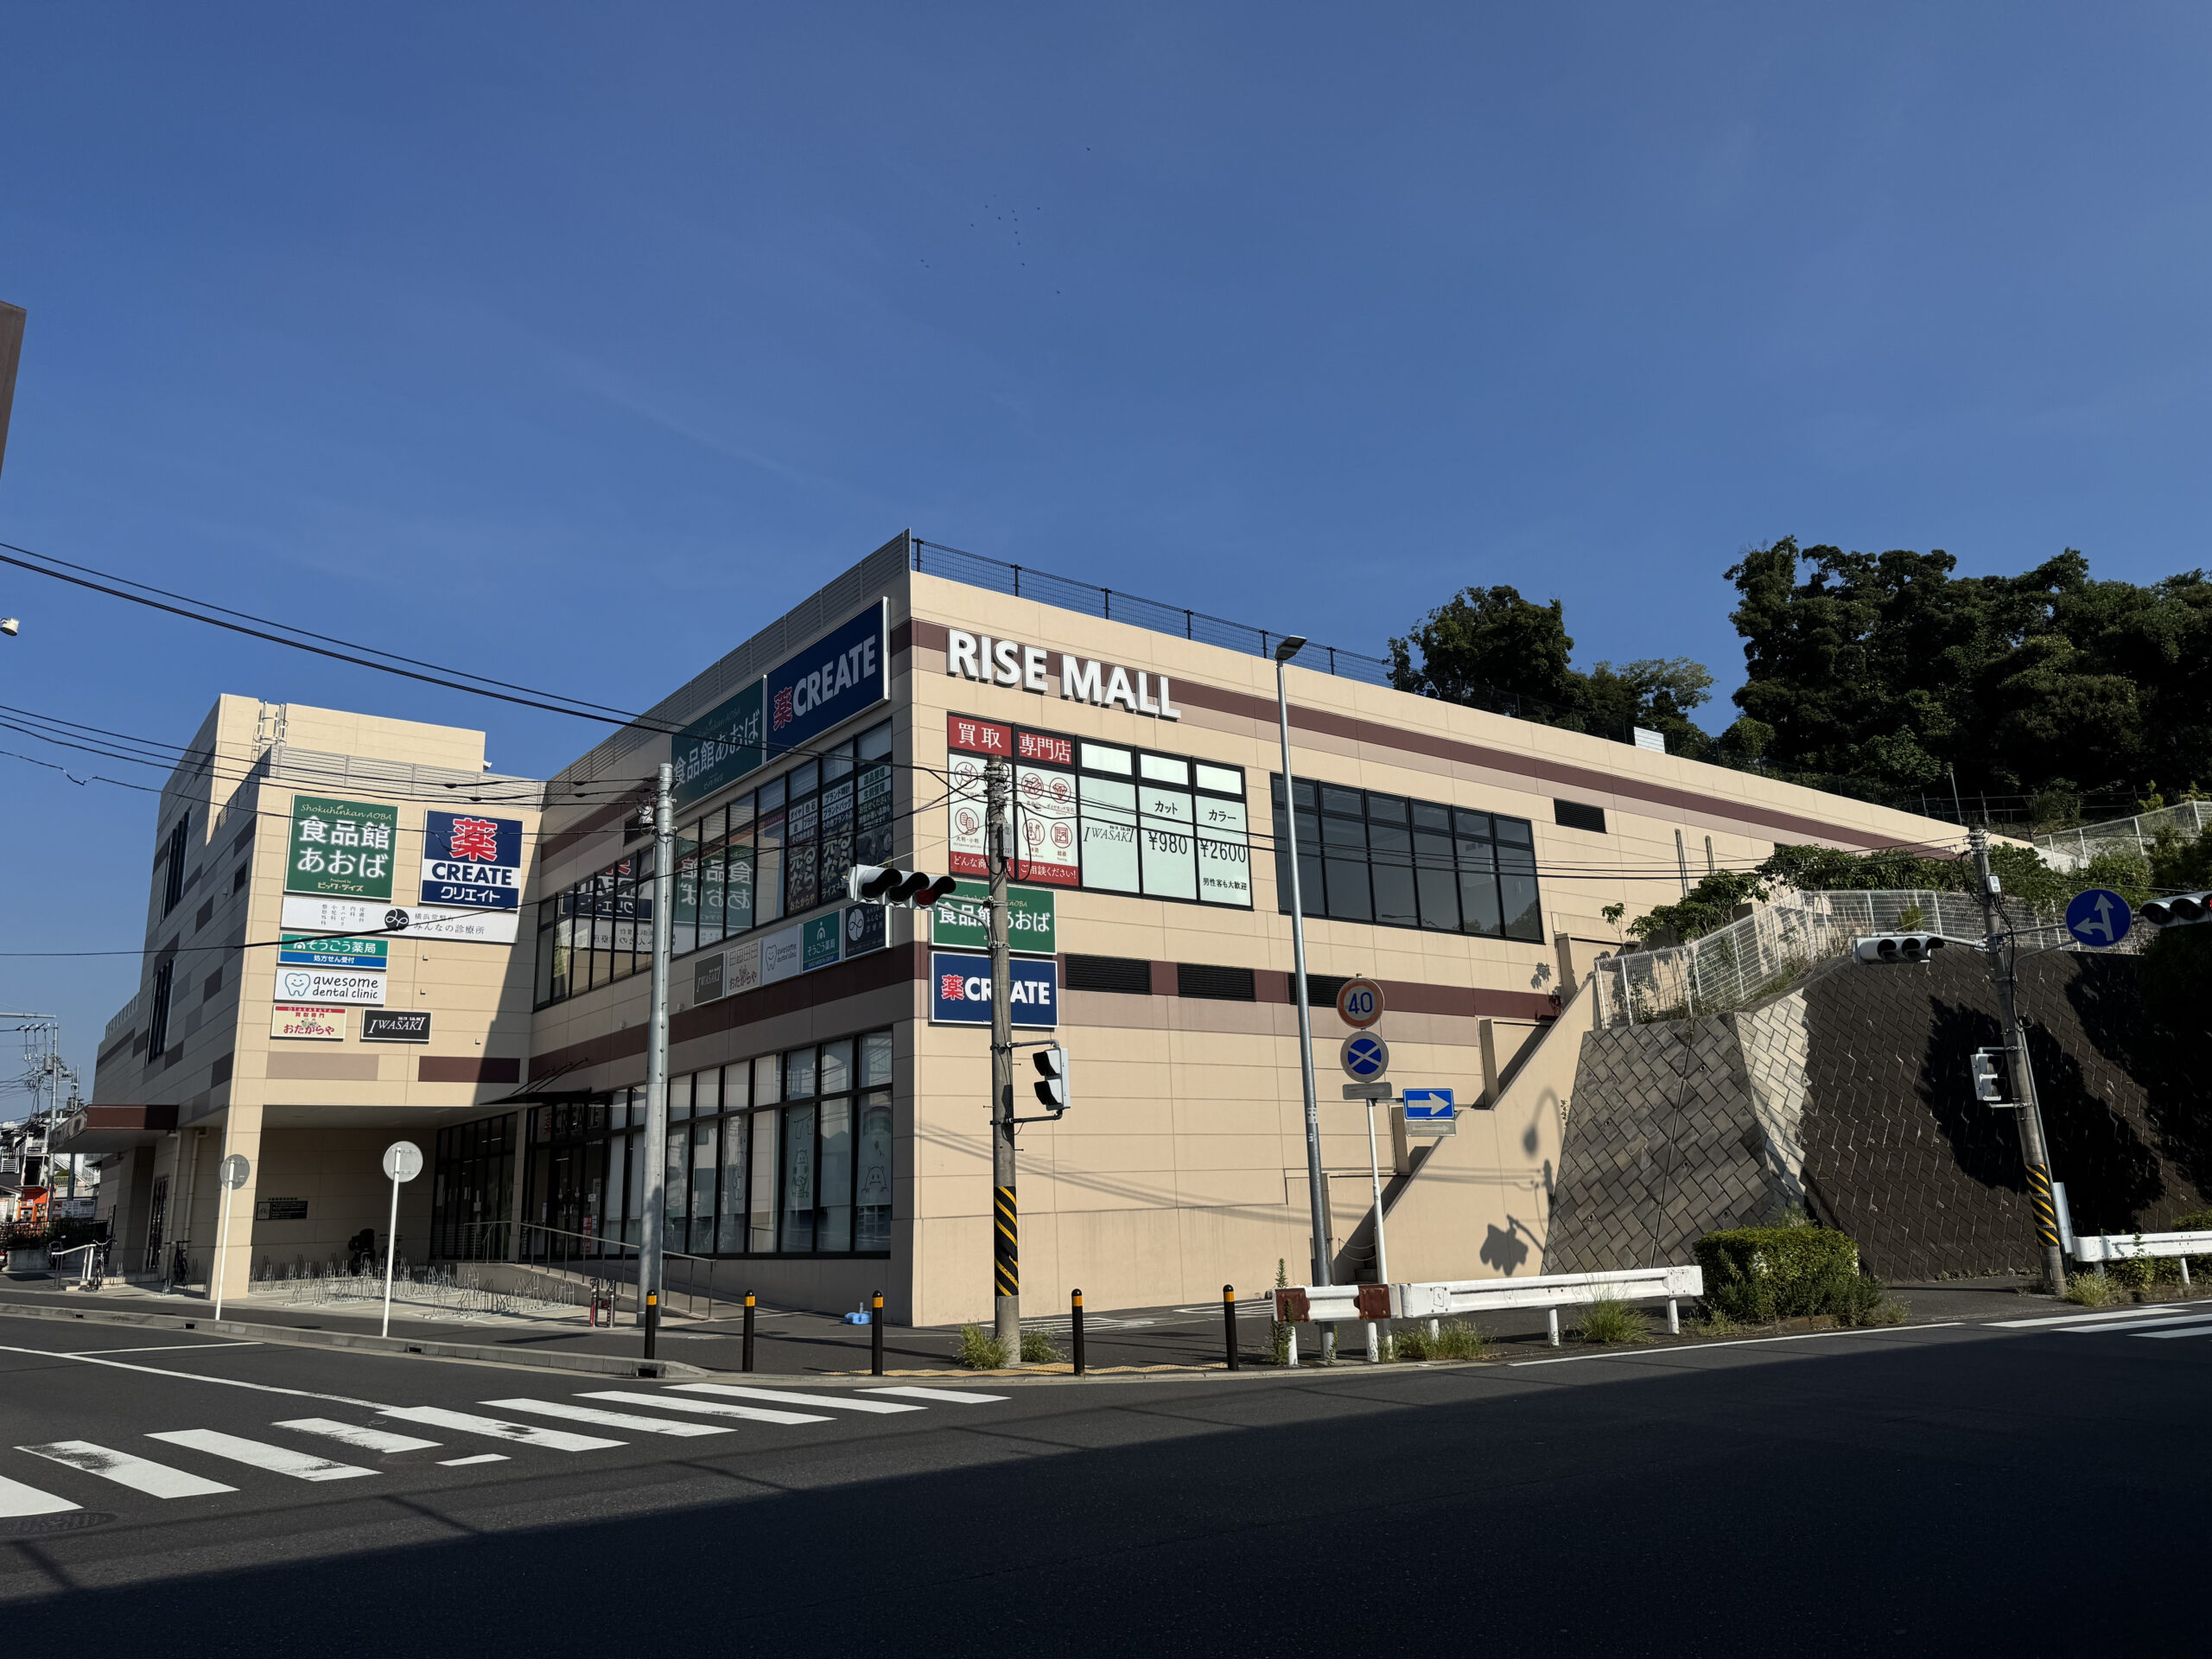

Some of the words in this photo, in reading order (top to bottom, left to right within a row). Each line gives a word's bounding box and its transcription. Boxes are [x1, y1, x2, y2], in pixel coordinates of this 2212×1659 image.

[773, 686, 792, 731] 薬
[793, 634, 875, 716] CREATE
[947, 628, 1048, 691] RISE
[1060, 654, 1181, 719] MALL
[673, 709, 760, 785] 食品館あおば
[958, 722, 1002, 749] 買取
[1019, 734, 1071, 763] 専門店
[301, 804, 365, 817] Shokuhinkan
[366, 811, 392, 821] AOBA
[1154, 800, 1179, 815] カット
[1208, 809, 1237, 823] カラー
[298, 815, 391, 850] 食品館
[449, 817, 498, 861] 薬
[1084, 826, 1135, 843] IWASAKI
[1148, 830, 1187, 855] ¥980
[296, 847, 389, 878] あおば
[1200, 839, 1246, 863] ¥2600
[431, 862, 512, 886] CREATE
[1203, 877, 1248, 891] 男性客も大歓迎
[441, 886, 500, 903] クリエイト
[313, 954, 355, 964] 処方せん受付
[313, 985, 348, 997] dental
[351, 988, 378, 999] clinic
[314, 976, 378, 988] awesome
[941, 974, 964, 1001] 薬
[964, 976, 1051, 1005] CRATE
[1348, 992, 1373, 1014] 40
[367, 1016, 427, 1034] IWASAKI
